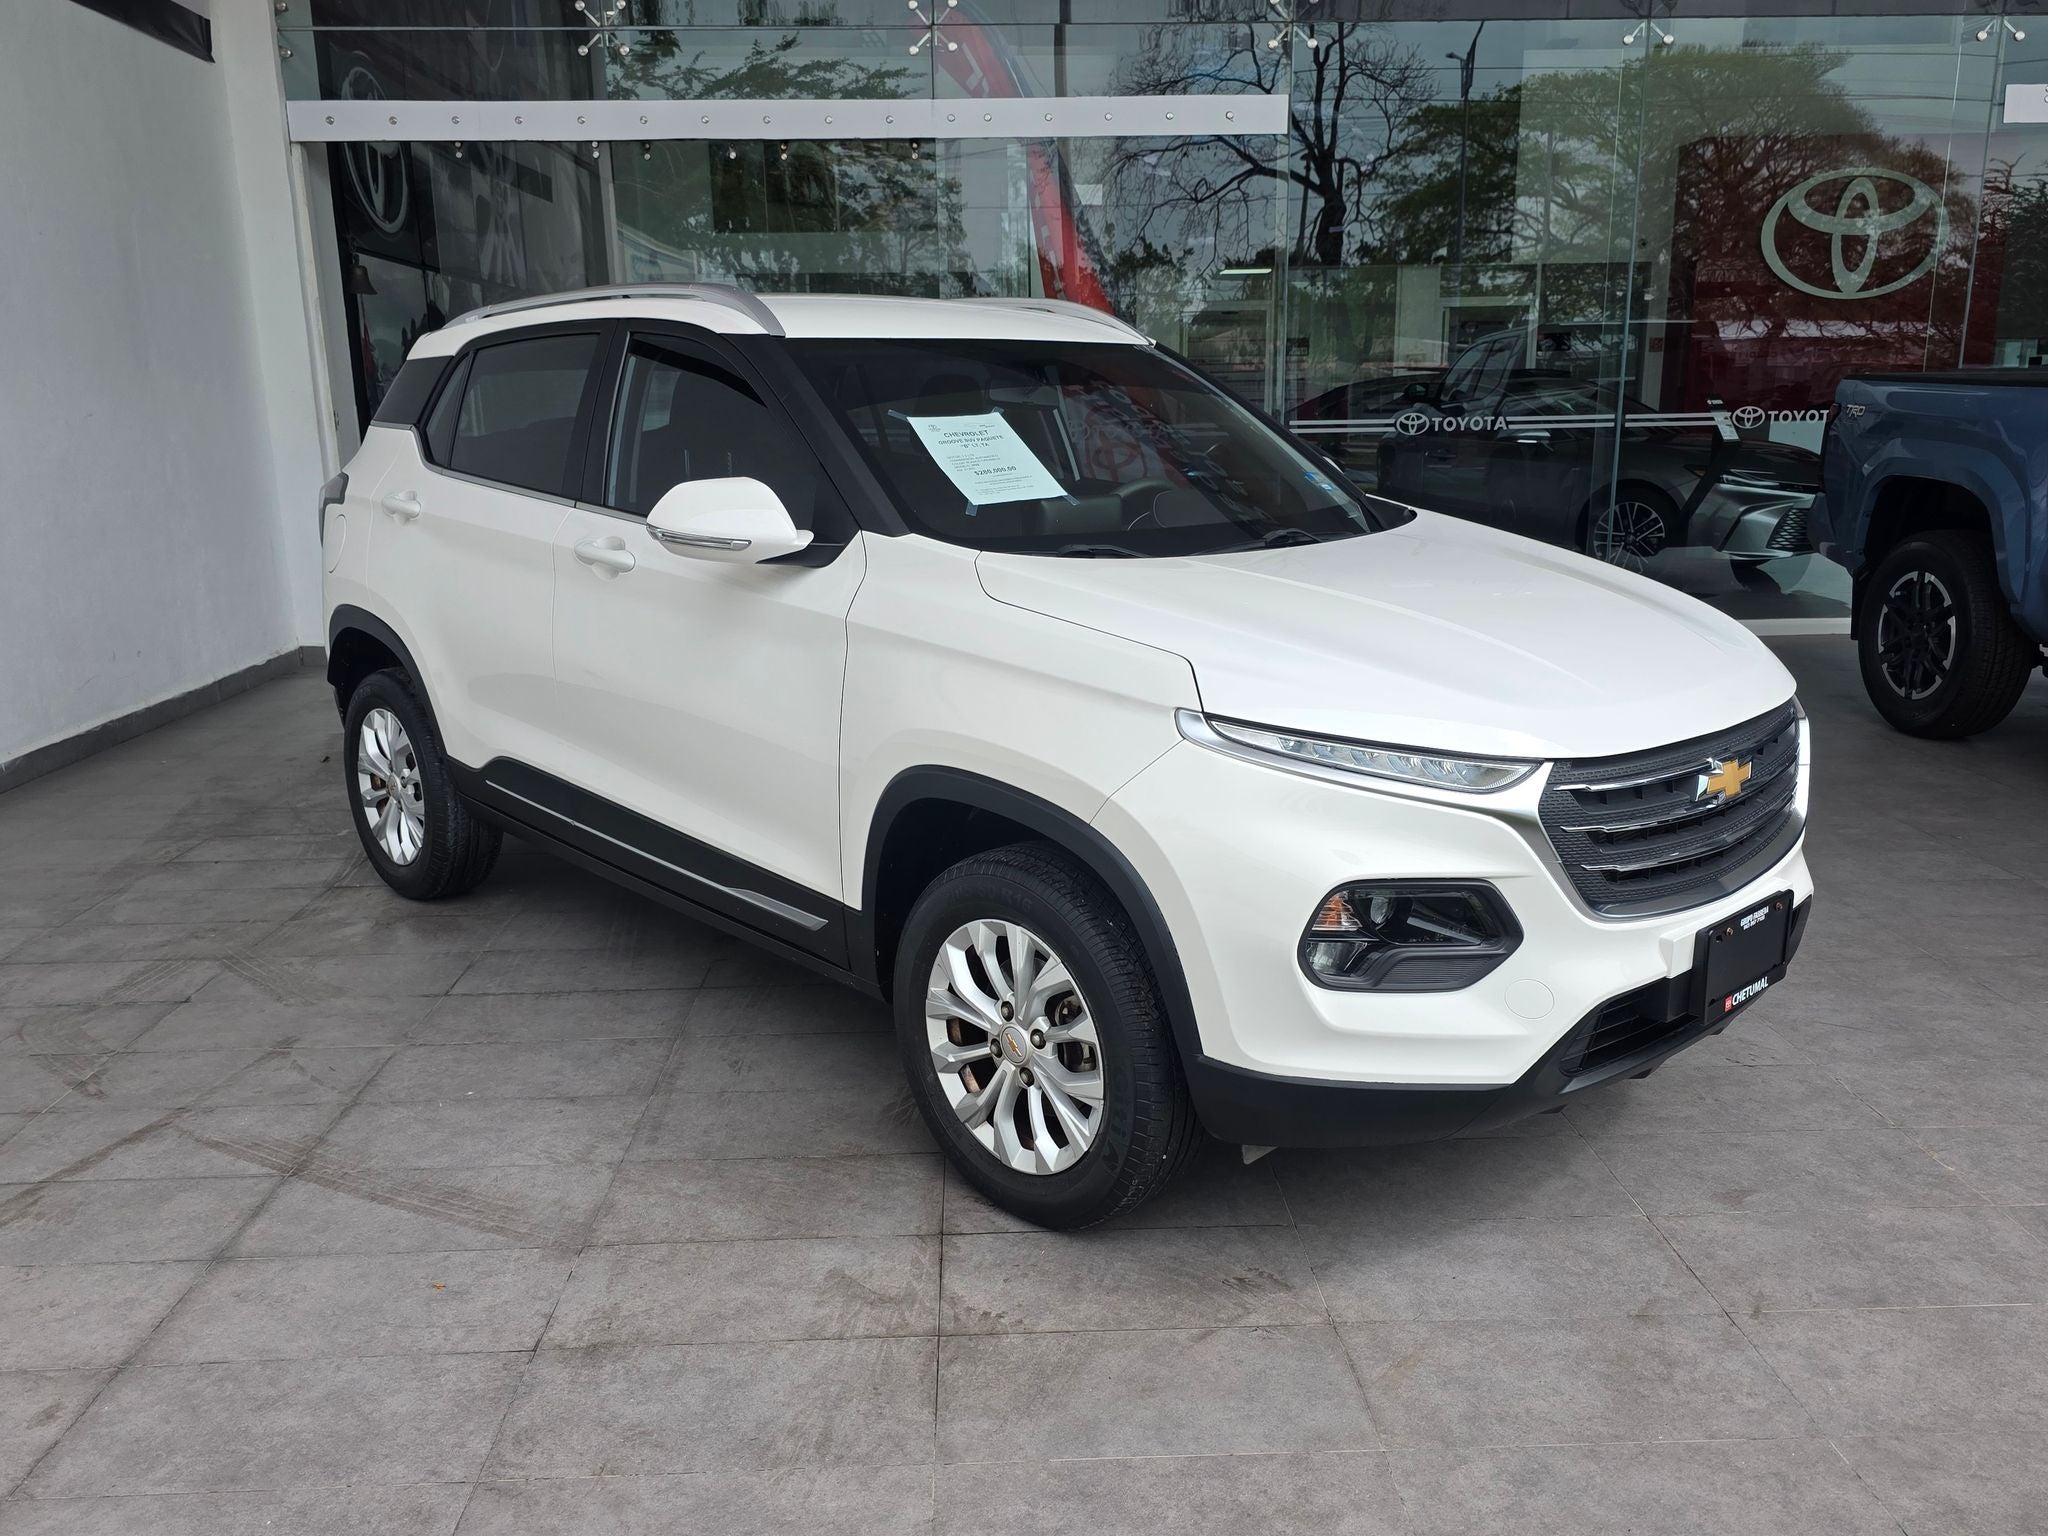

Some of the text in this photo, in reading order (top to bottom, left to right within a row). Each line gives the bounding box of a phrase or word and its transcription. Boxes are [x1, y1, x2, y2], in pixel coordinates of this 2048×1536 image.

[1767, 409, 1830, 425] TOYOT
[1847, 404, 1866, 417] TRD
[1431, 416, 1508, 432] TOYOTA
[943, 430, 989, 438] CHEVROLET
[1732, 976, 1769, 1006] CHETUMAL
